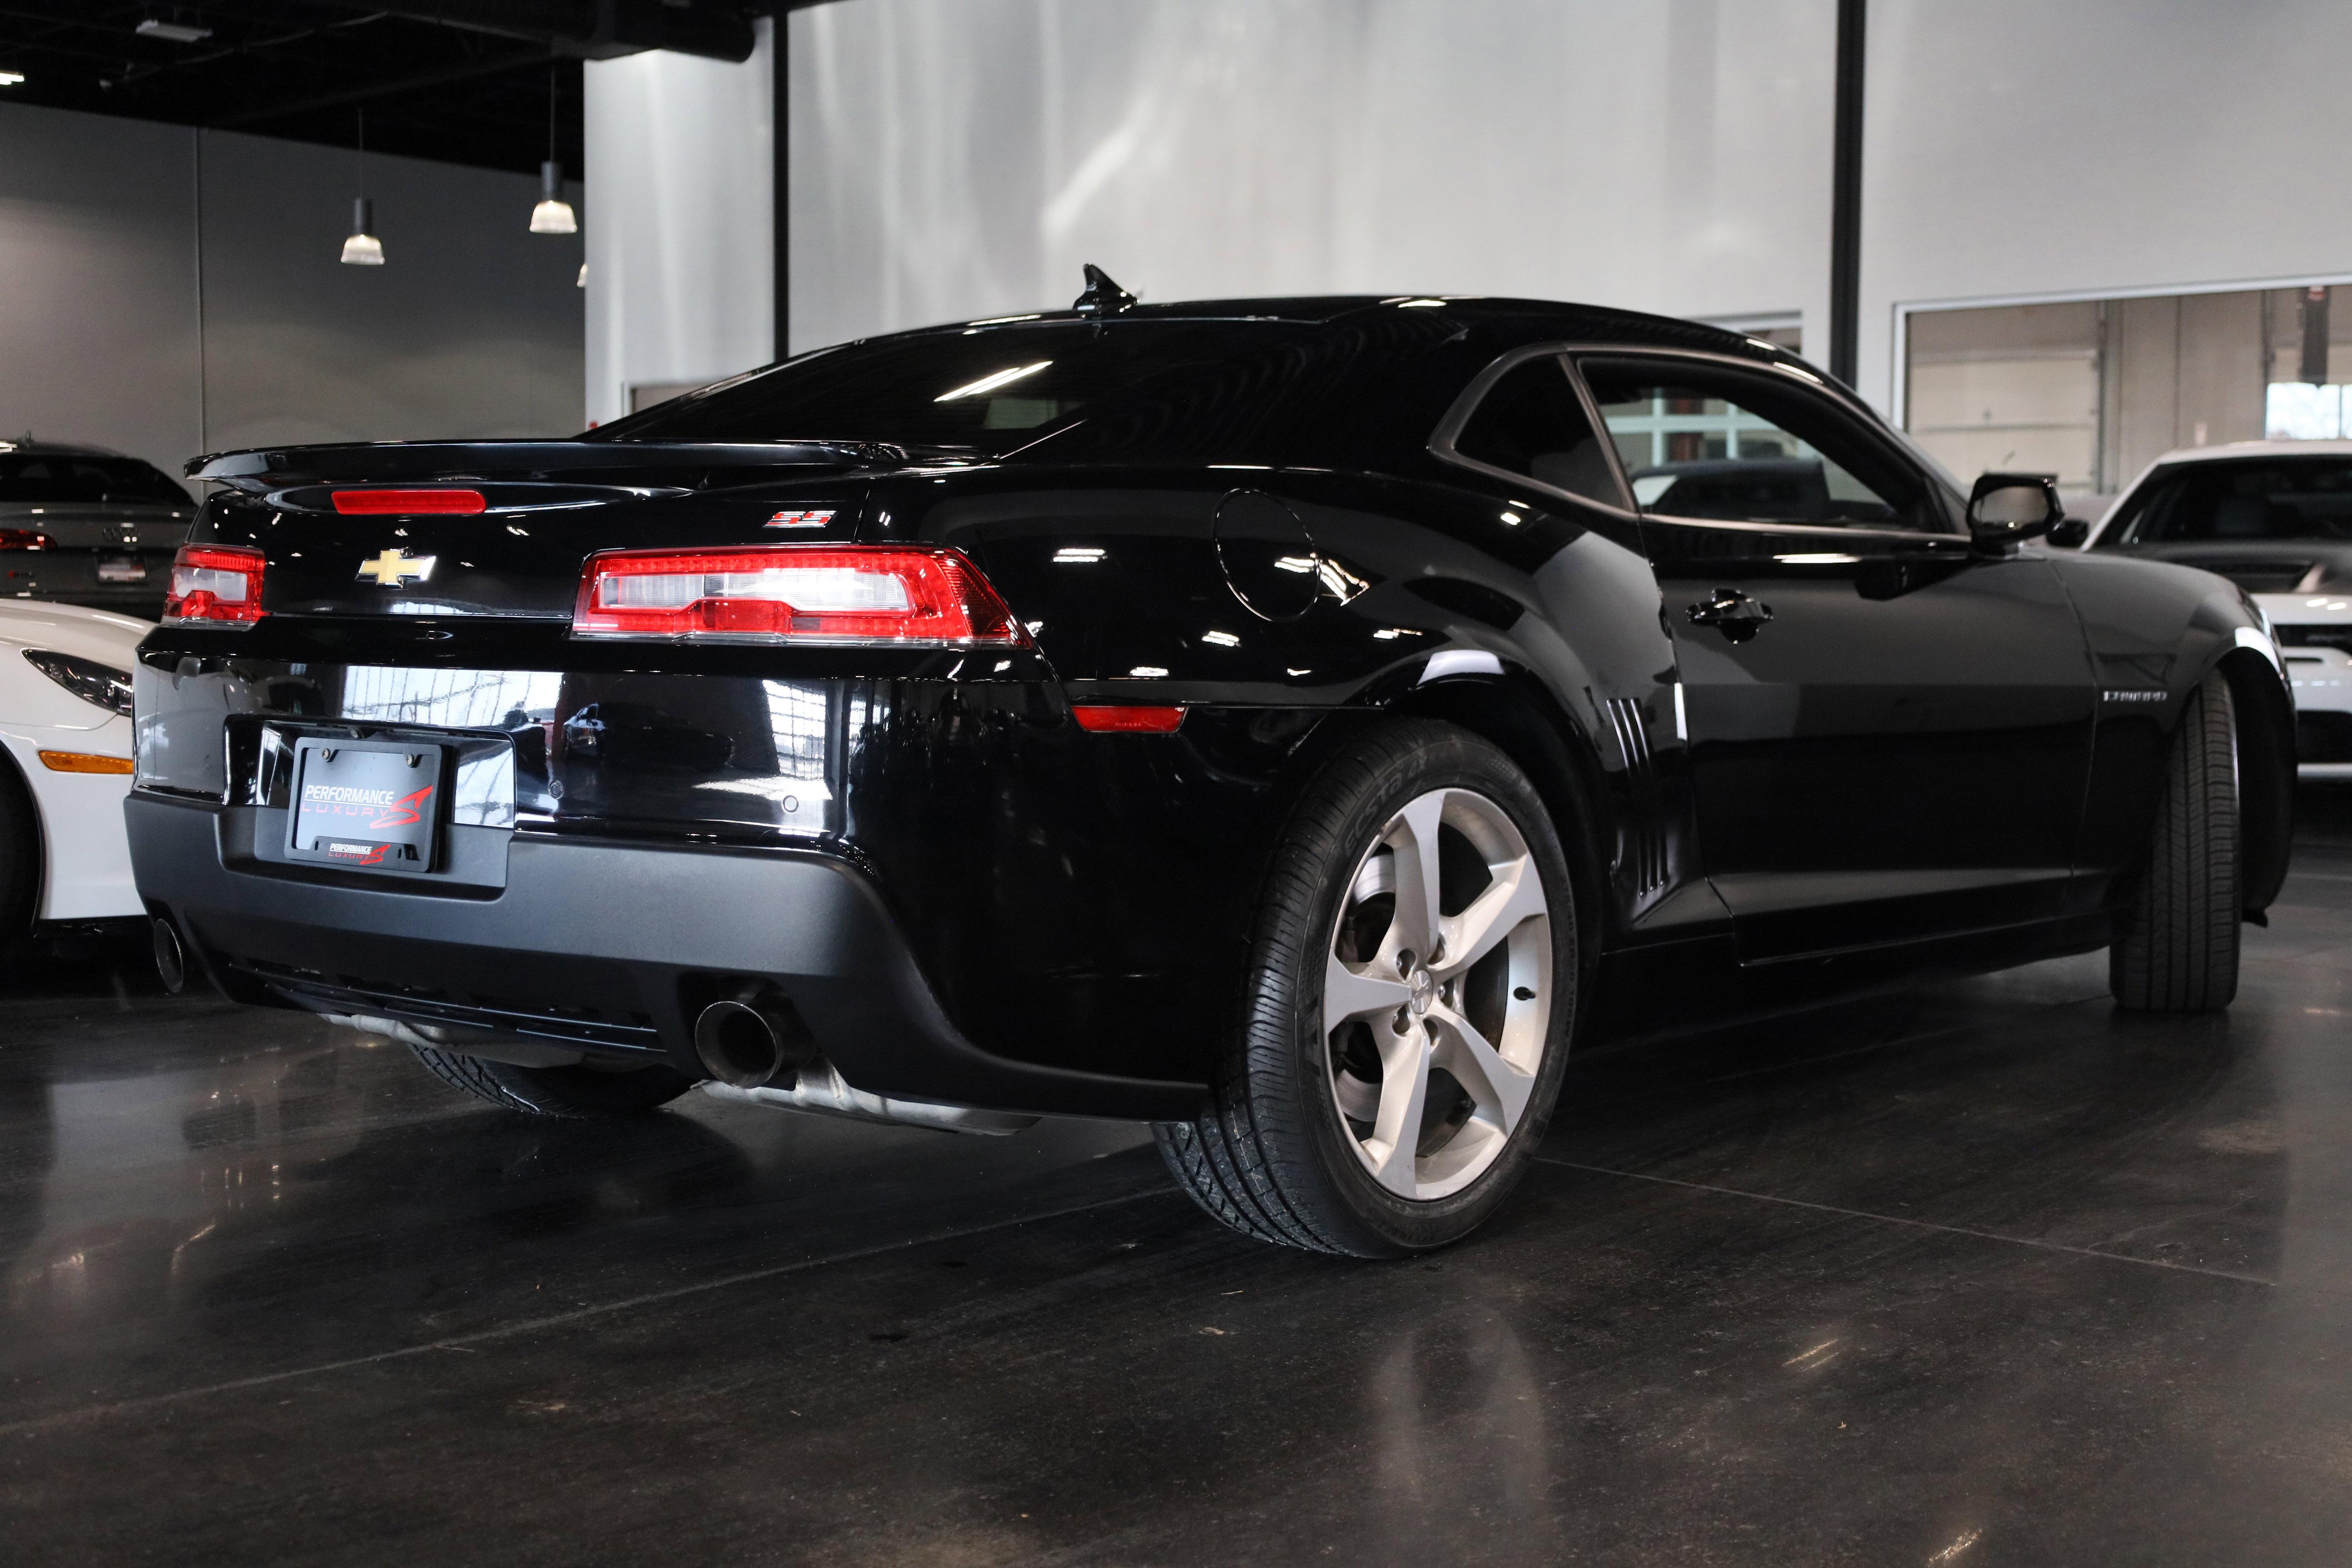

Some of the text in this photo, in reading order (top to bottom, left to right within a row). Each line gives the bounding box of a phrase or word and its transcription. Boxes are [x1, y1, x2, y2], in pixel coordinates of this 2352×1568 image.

[763, 511, 837, 528] SS
[304, 785, 394, 805] PERFORMANCE
[301, 802, 390, 817] LUXURY
[330, 843, 372, 853] PERFORMANCE
